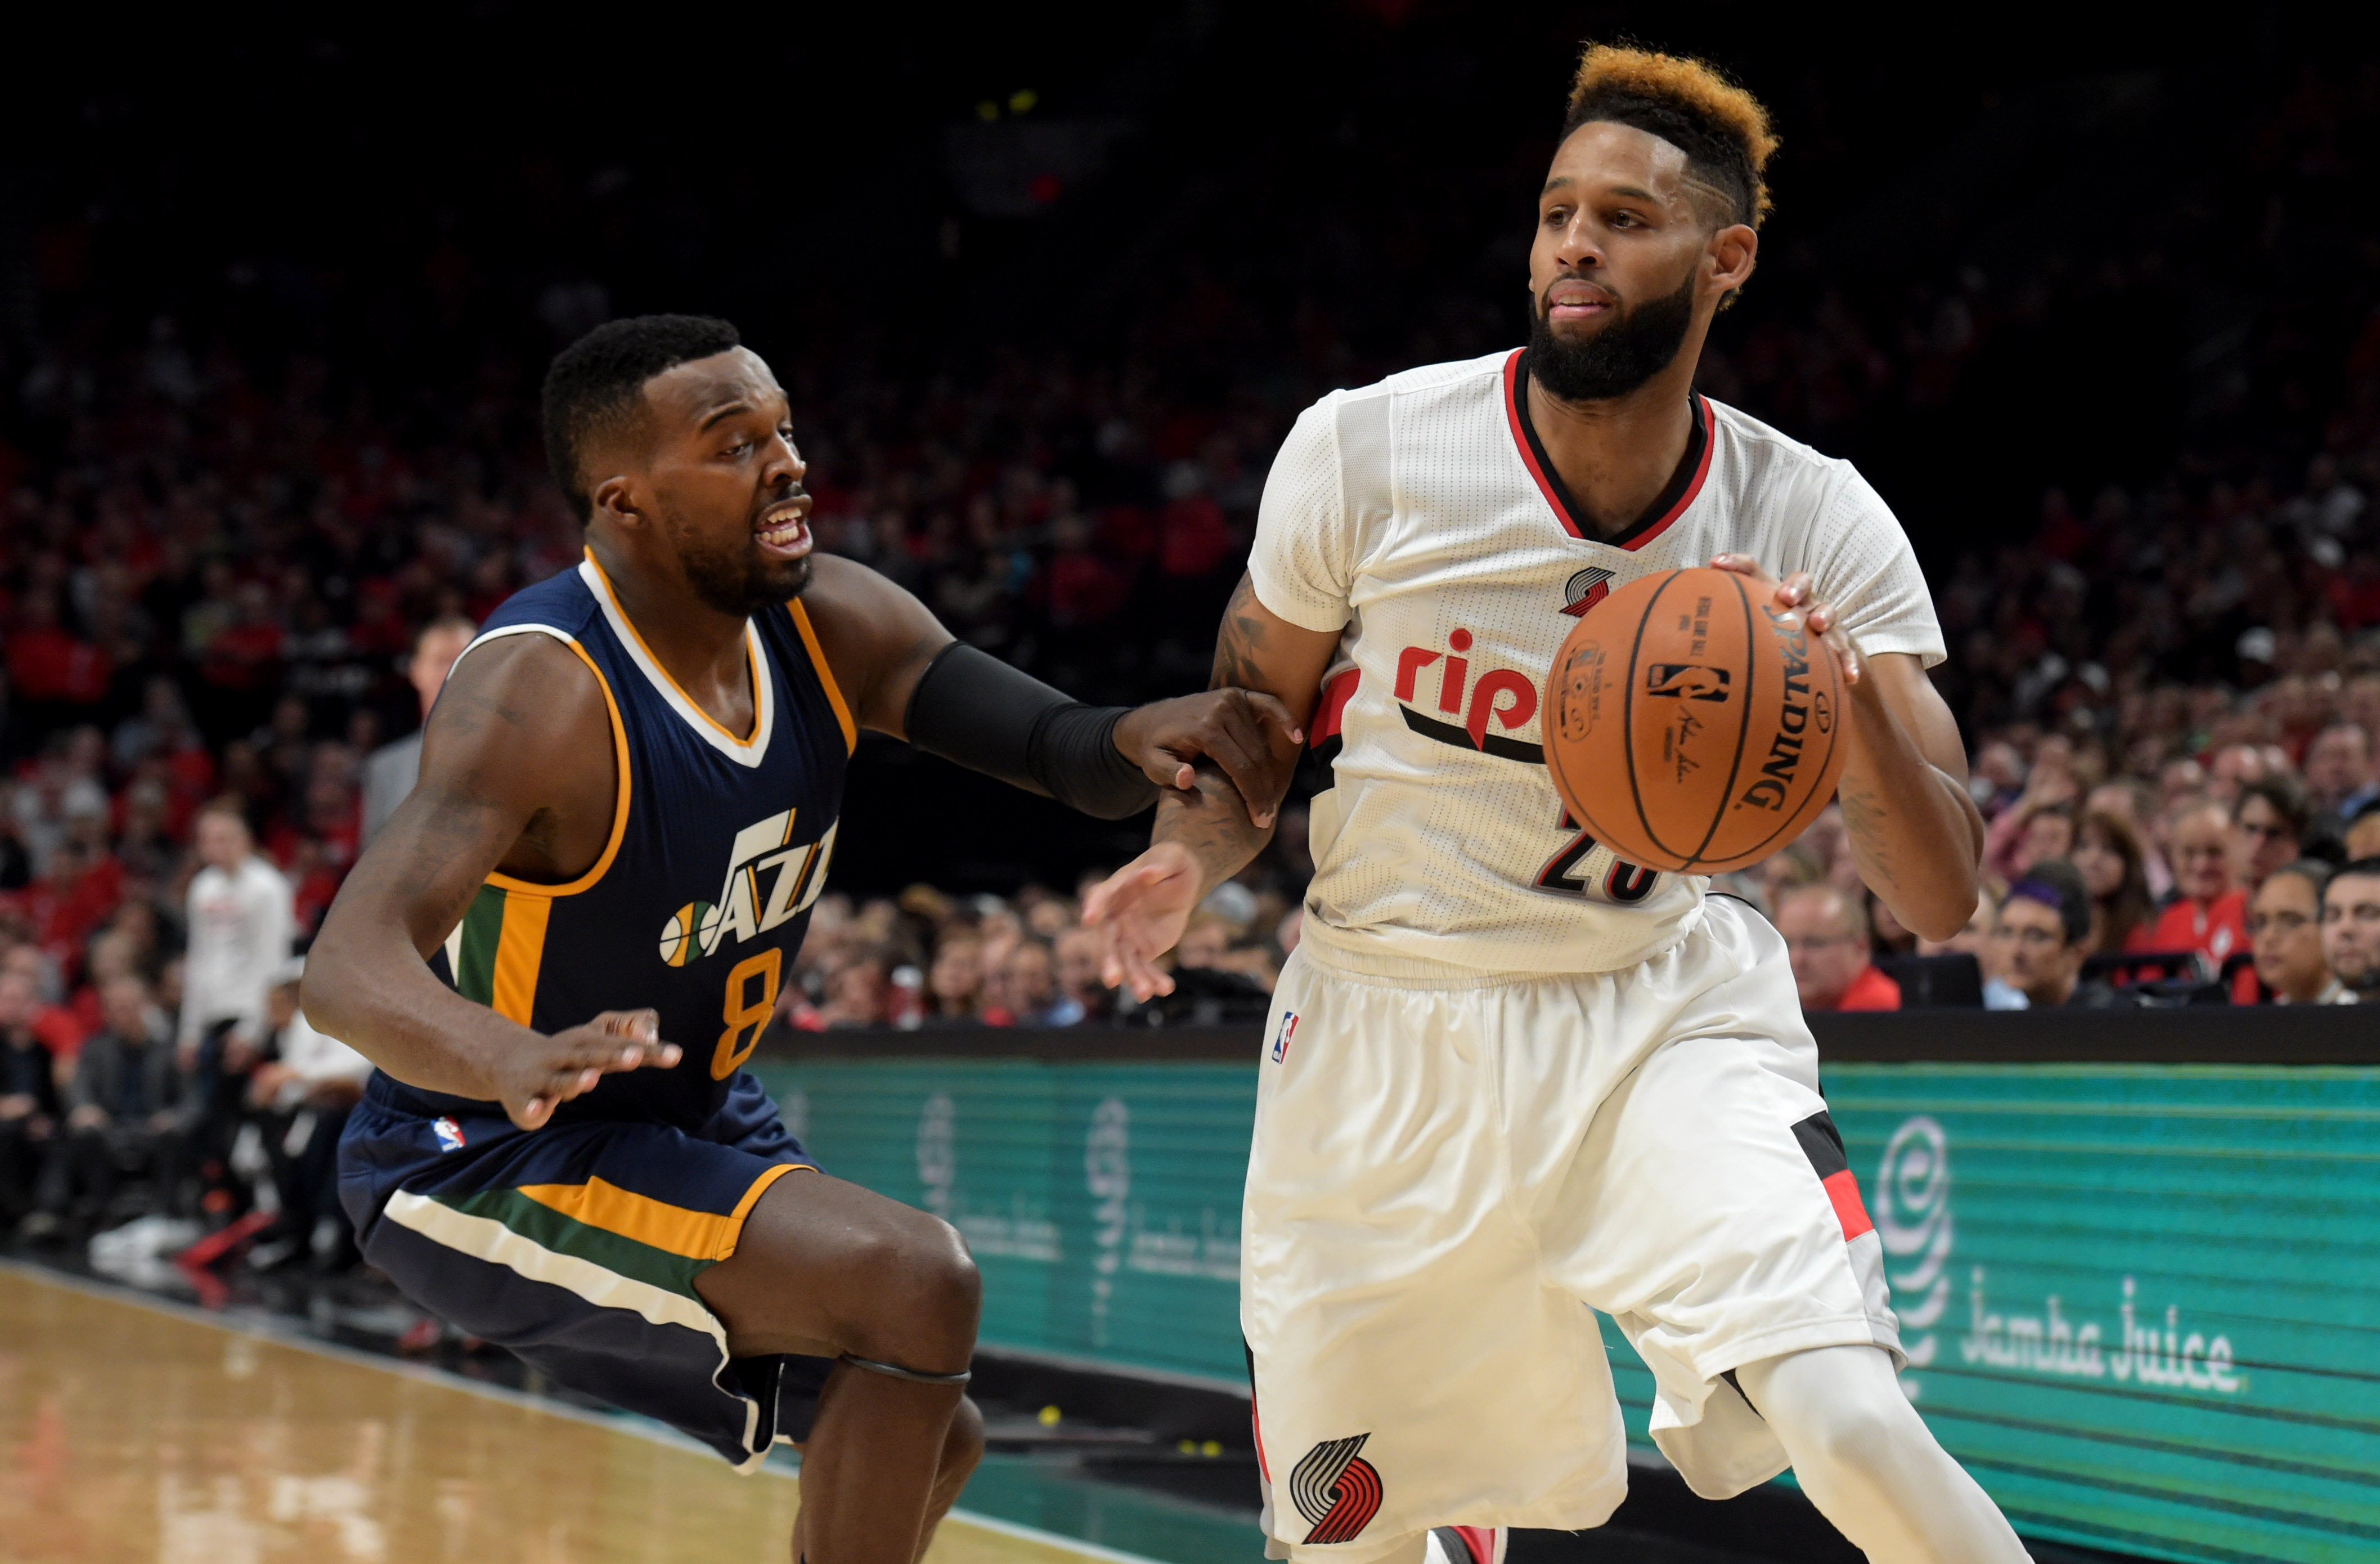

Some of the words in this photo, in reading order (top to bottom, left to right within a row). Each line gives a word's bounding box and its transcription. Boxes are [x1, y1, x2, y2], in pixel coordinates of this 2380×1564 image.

[1393, 628, 1537, 752] rip
[1741, 604, 1809, 812] SPALDING
[710, 947, 782, 1081] 8
[1960, 1266, 2105, 1377] Jamba
[2111, 1275, 2241, 1392] Juice
